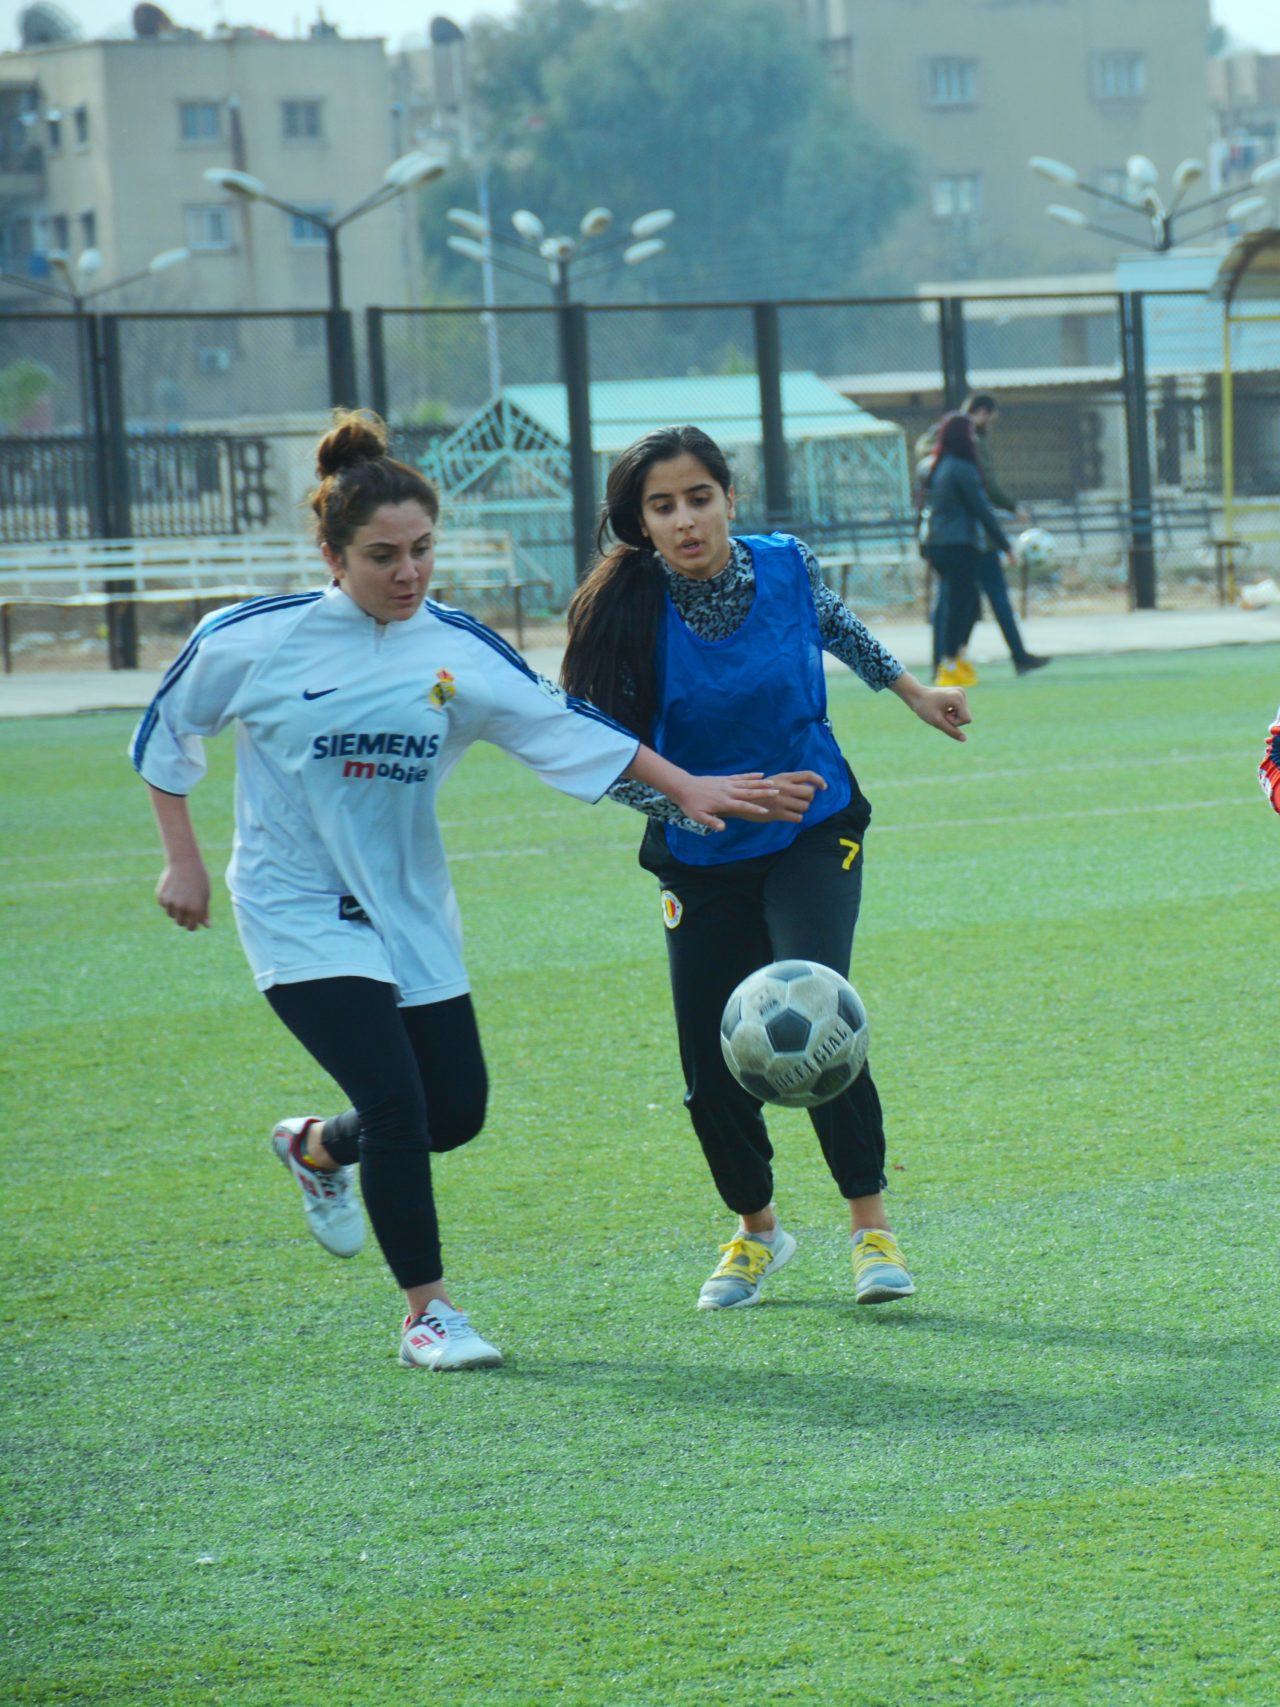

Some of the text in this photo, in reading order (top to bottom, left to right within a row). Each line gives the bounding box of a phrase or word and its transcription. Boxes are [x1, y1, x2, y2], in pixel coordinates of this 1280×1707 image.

[313, 733, 439, 759] SIEMENS
[839, 838, 860, 870] 7
[775, 1026, 848, 1090] OFFICIAL
